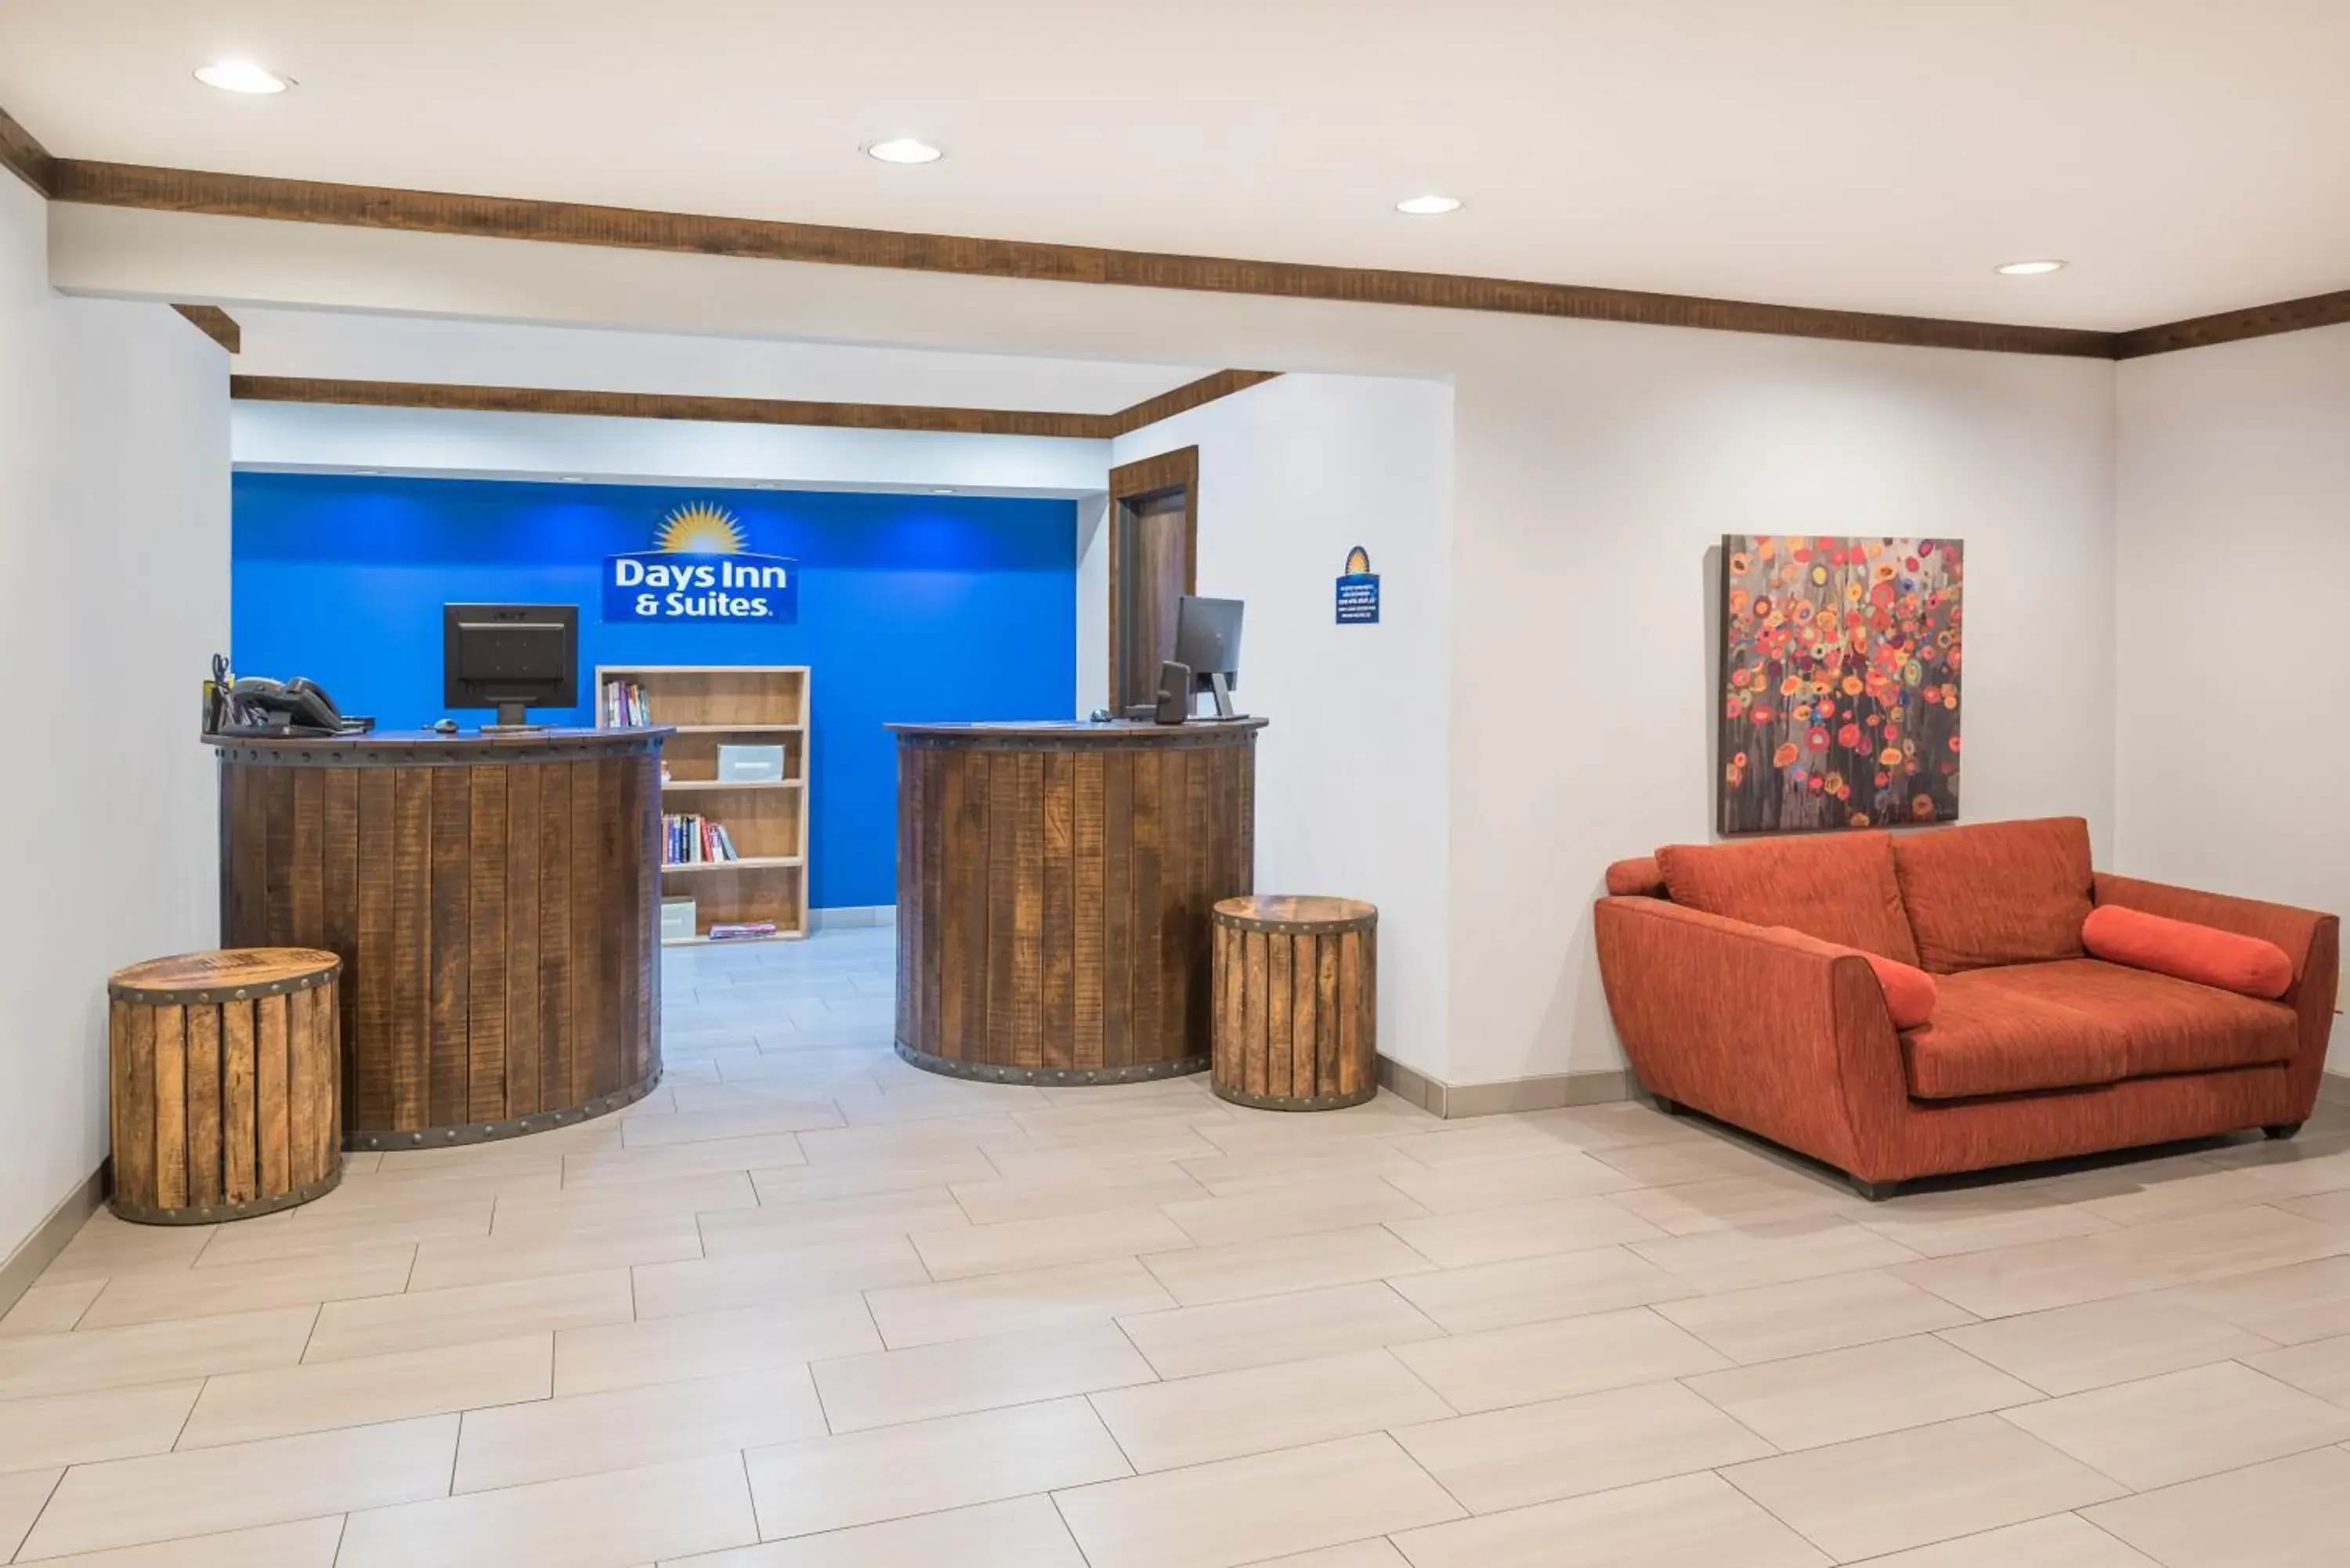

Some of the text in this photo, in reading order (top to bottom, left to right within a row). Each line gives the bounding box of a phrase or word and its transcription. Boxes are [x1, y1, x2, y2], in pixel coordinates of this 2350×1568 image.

[616, 559, 786, 591] Days Inn
[635, 594, 659, 616] &
